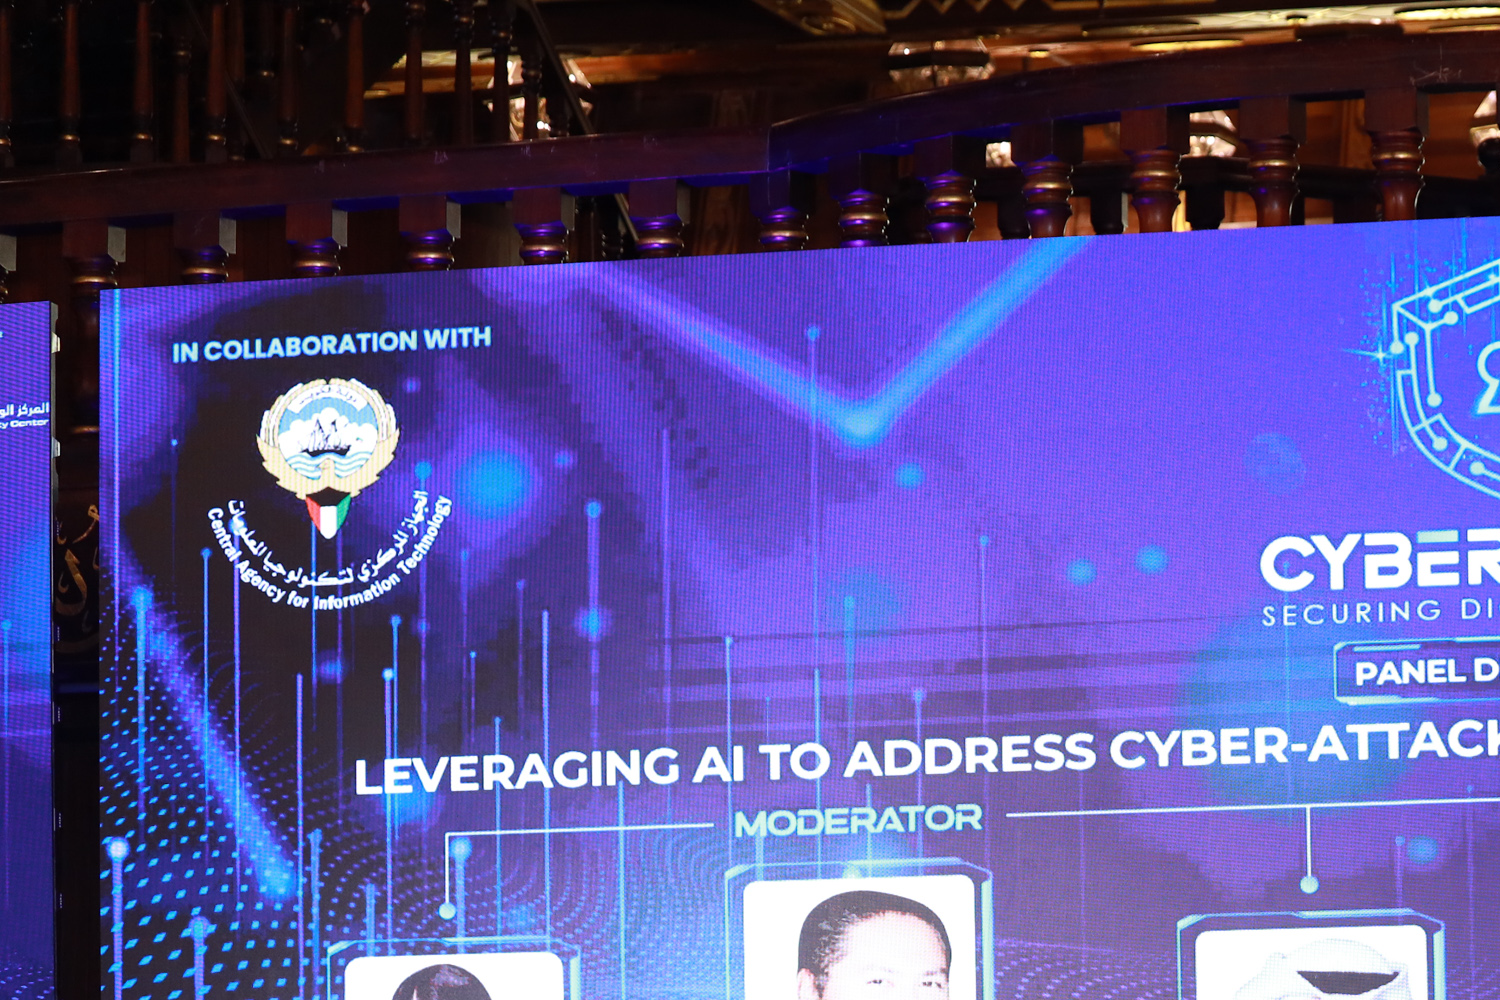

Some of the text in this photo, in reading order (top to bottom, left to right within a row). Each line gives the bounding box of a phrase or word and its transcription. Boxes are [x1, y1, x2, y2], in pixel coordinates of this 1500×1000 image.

[173, 326, 492, 363] IN COLLABORATION WITH
[10, 419, 49, 428] Center
[17, 402, 49, 417] المركز
[208, 495, 452, 610] Central Agency for Information Technology
[1262, 599, 1442, 627] SECURING
[1355, 658, 1465, 686] PANEL
[355, 746, 680, 795] LEVERAGING
[694, 744, 745, 784] AI
[759, 741, 831, 781] TO
[843, 732, 1097, 778] ADDRESS
[735, 803, 983, 838] MODERATOR
